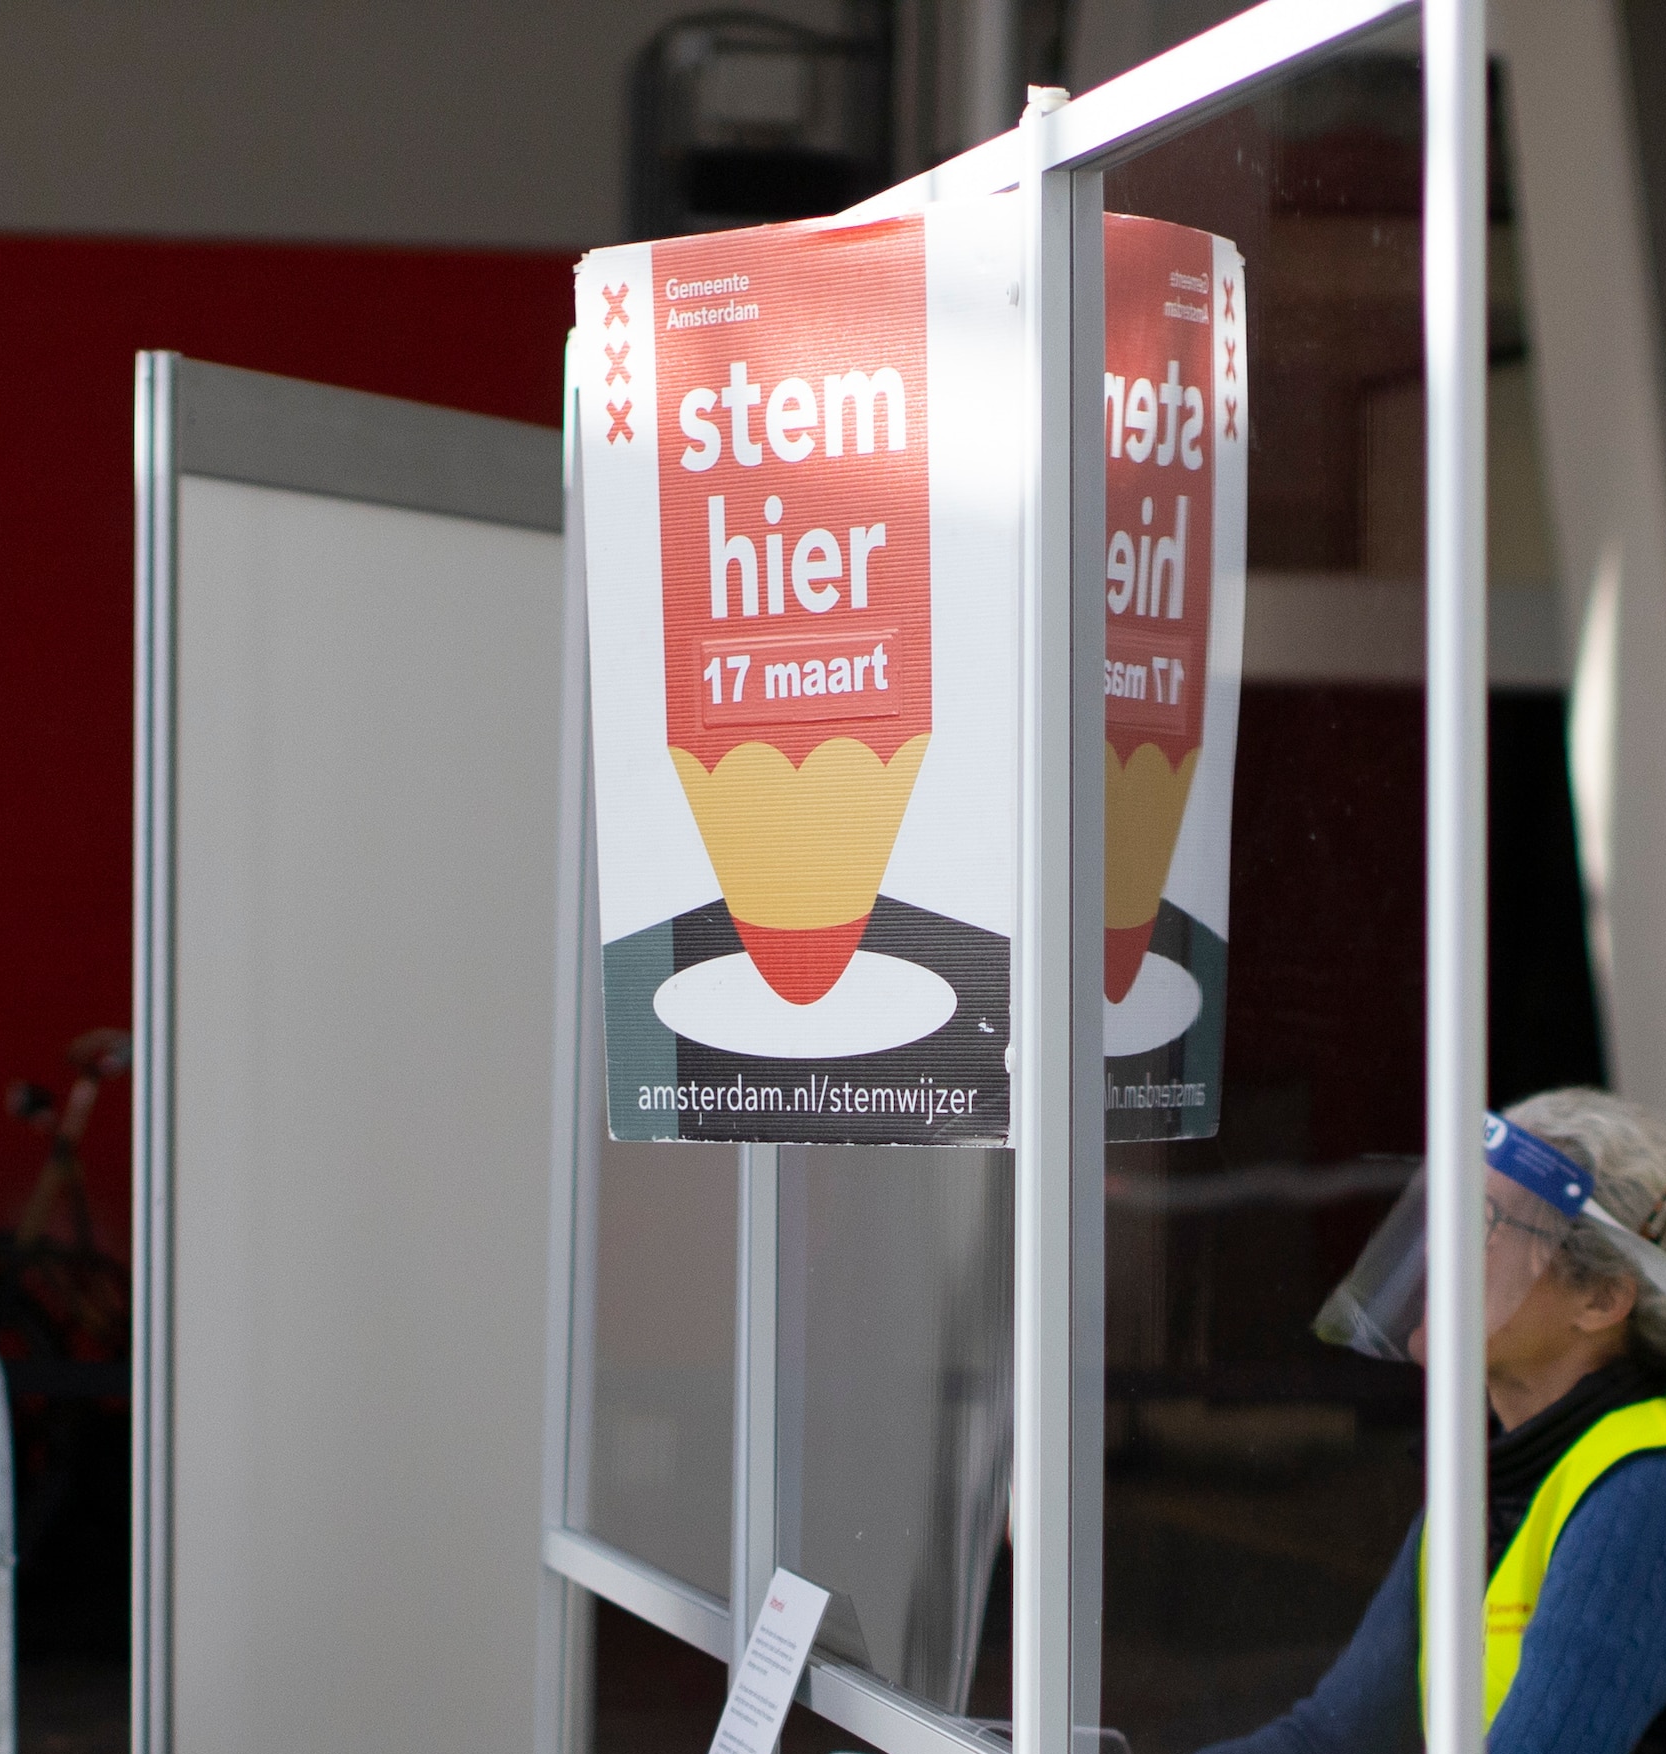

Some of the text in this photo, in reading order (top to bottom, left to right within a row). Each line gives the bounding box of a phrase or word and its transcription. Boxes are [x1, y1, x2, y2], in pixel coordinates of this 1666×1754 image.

[666, 272, 750, 301] Gemeente
[666, 299, 760, 330] Amsterdam
[679, 361, 907, 472] stem
[707, 494, 887, 620] hier
[703, 642, 890, 706] 17 maart
[637, 1074, 978, 1125] amsterdam.nl/stemwijzer
